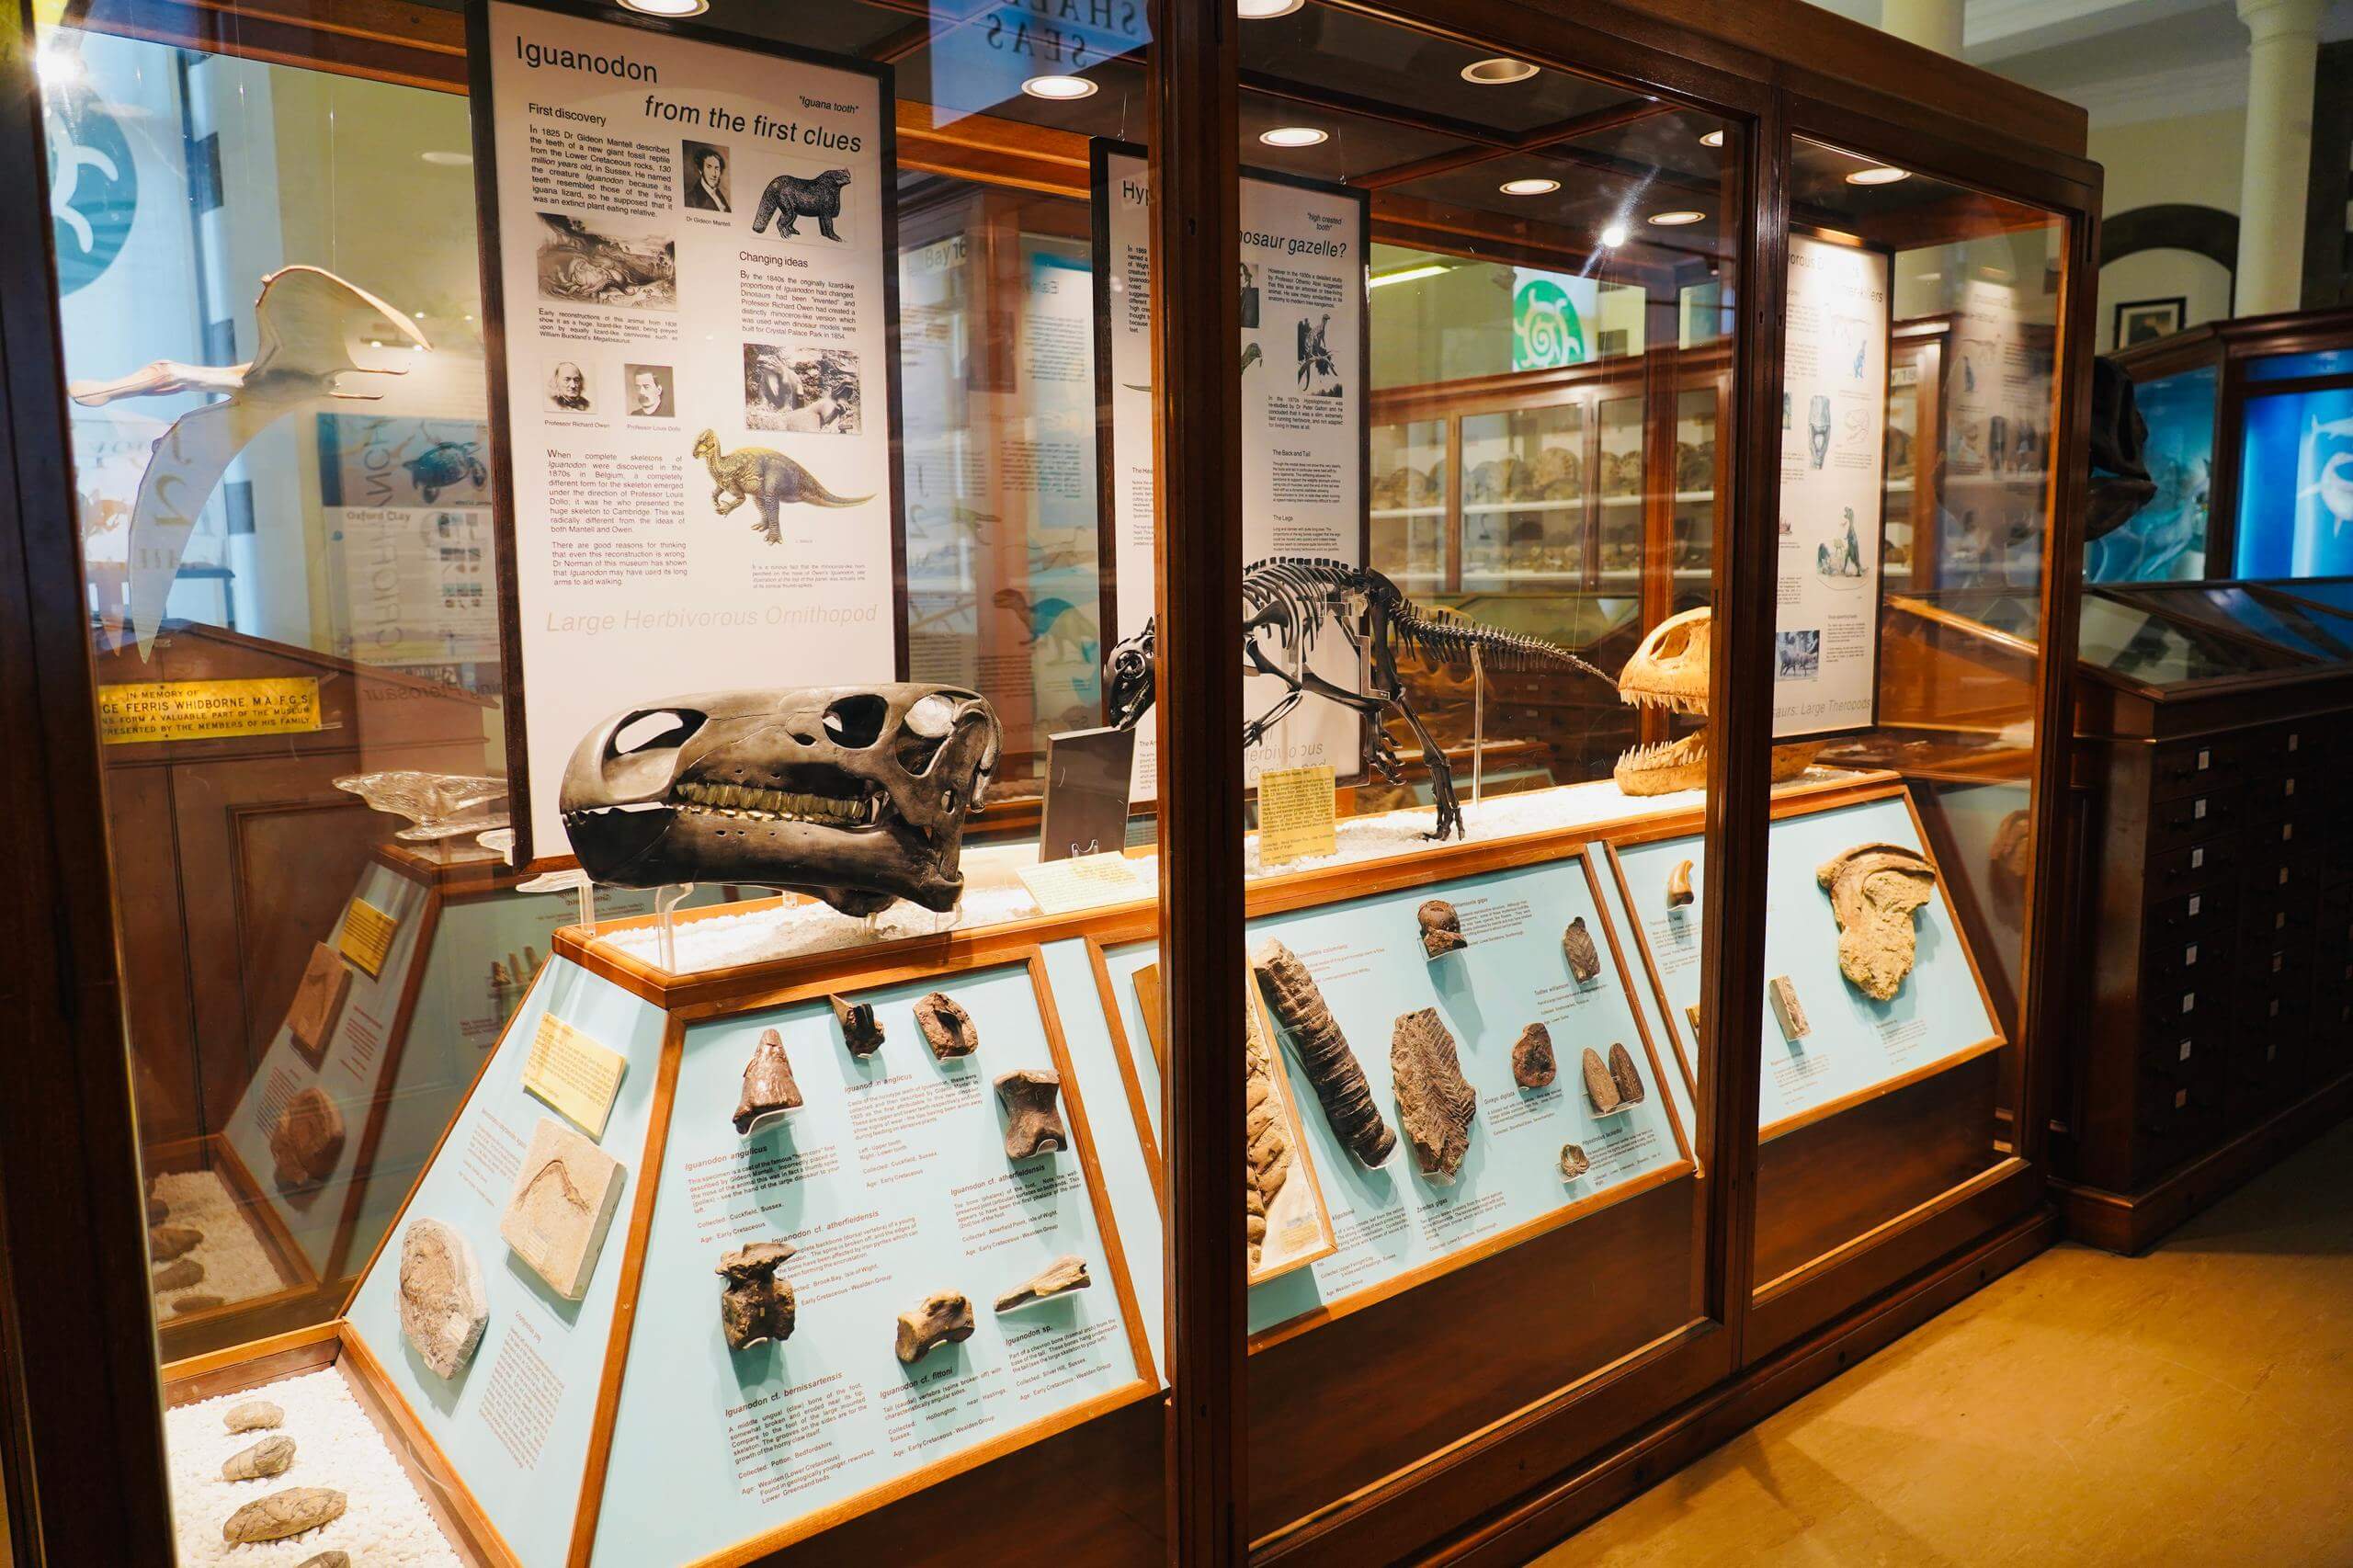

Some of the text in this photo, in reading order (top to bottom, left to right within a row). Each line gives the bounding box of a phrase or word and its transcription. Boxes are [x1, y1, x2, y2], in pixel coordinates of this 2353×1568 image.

[517, 36, 658, 84] Iguanodon
[529, 103, 607, 127] First discovery
[645, 95, 861, 153] from the first clues
[529, 125, 537, 133] In
[542, 129, 560, 137] 1825
[577, 133, 603, 143] Gideon
[608, 138, 632, 148] Mantell
[636, 143, 669, 153] described
[530, 136, 541, 144] the
[546, 139, 564, 147] teeth
[607, 149, 624, 157] giant
[628, 151, 645, 159] fossil
[650, 155, 670, 164] reptile
[530, 146, 547, 154] from
[551, 149, 562, 157] the
[565, 152, 587, 160] Lower
[591, 156, 631, 167] Cretaceous
[531, 157, 555, 165] million
[557, 161, 577, 169] years
[647, 173, 671, 182] named
[549, 169, 580, 178] creature
[585, 173, 623, 185] Iguanodon
[629, 180, 658, 189] because
[532, 176, 551, 184] teeth
[557, 179, 595, 190] resembled
[600, 185, 620, 193] those
[654, 192, 672, 201] living
[533, 186, 557, 196] iguana
[614, 197, 647, 207] supposed
[562, 199, 585, 208] extinct
[587, 202, 605, 211] plant
[607, 206, 629, 215] eating
[694, 217, 711, 226] Gideon
[1288, 238, 1347, 257] gazelle?
[739, 251, 809, 267] Changing ideas
[547, 604, 878, 635] Large Herbivorous Ornithopod
[126, 692, 137, 700] IN
[142, 690, 183, 699] MEMORY
[126, 702, 169, 712] FERRIS
[175, 698, 244, 710] WHIDBORNE
[1802, 702, 1824, 716] Large
[1829, 698, 1871, 713] Theropods
[199, 721, 243, 730] MEMBERS
[884, 1074, 913, 1085] anglicus
[685, 1155, 727, 1171] Iguanodon
[950, 1182, 985, 1197] Iguanodon
[1006, 1329, 1040, 1346] Iguanodon
[880, 1381, 918, 1399] Iguanodon
[932, 1367, 953, 1380] fittoni
[725, 1398, 767, 1417] Iguanodon
[784, 1372, 843, 1396] bernissartensis
[738, 1418, 757, 1429] middle
[808, 1397, 823, 1405] bone
